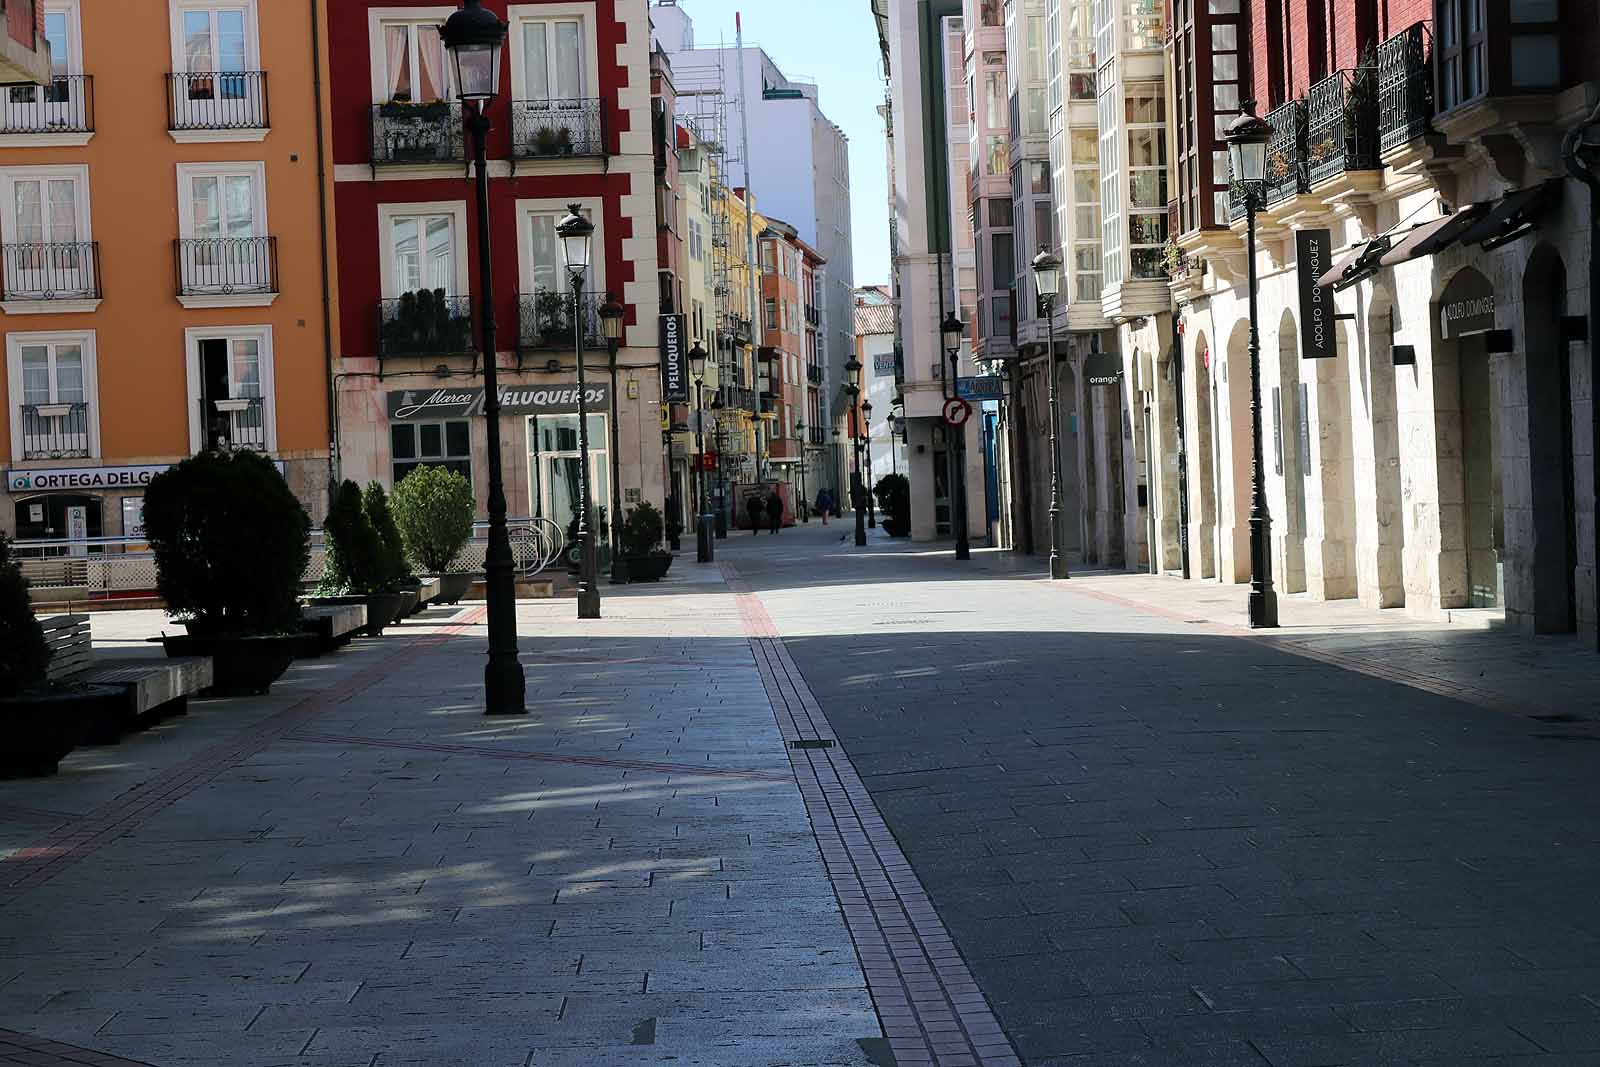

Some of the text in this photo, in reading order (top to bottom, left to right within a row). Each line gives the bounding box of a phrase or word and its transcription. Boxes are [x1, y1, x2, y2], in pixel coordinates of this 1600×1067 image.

[1309, 239, 1324, 349] ADOLFO DOMINGUEZ
[667, 315, 680, 390] PELUQUEROS
[1090, 376, 1117, 385] orange
[34, 473, 104, 488] ORTEGA
[107, 471, 160, 485] DELGA
